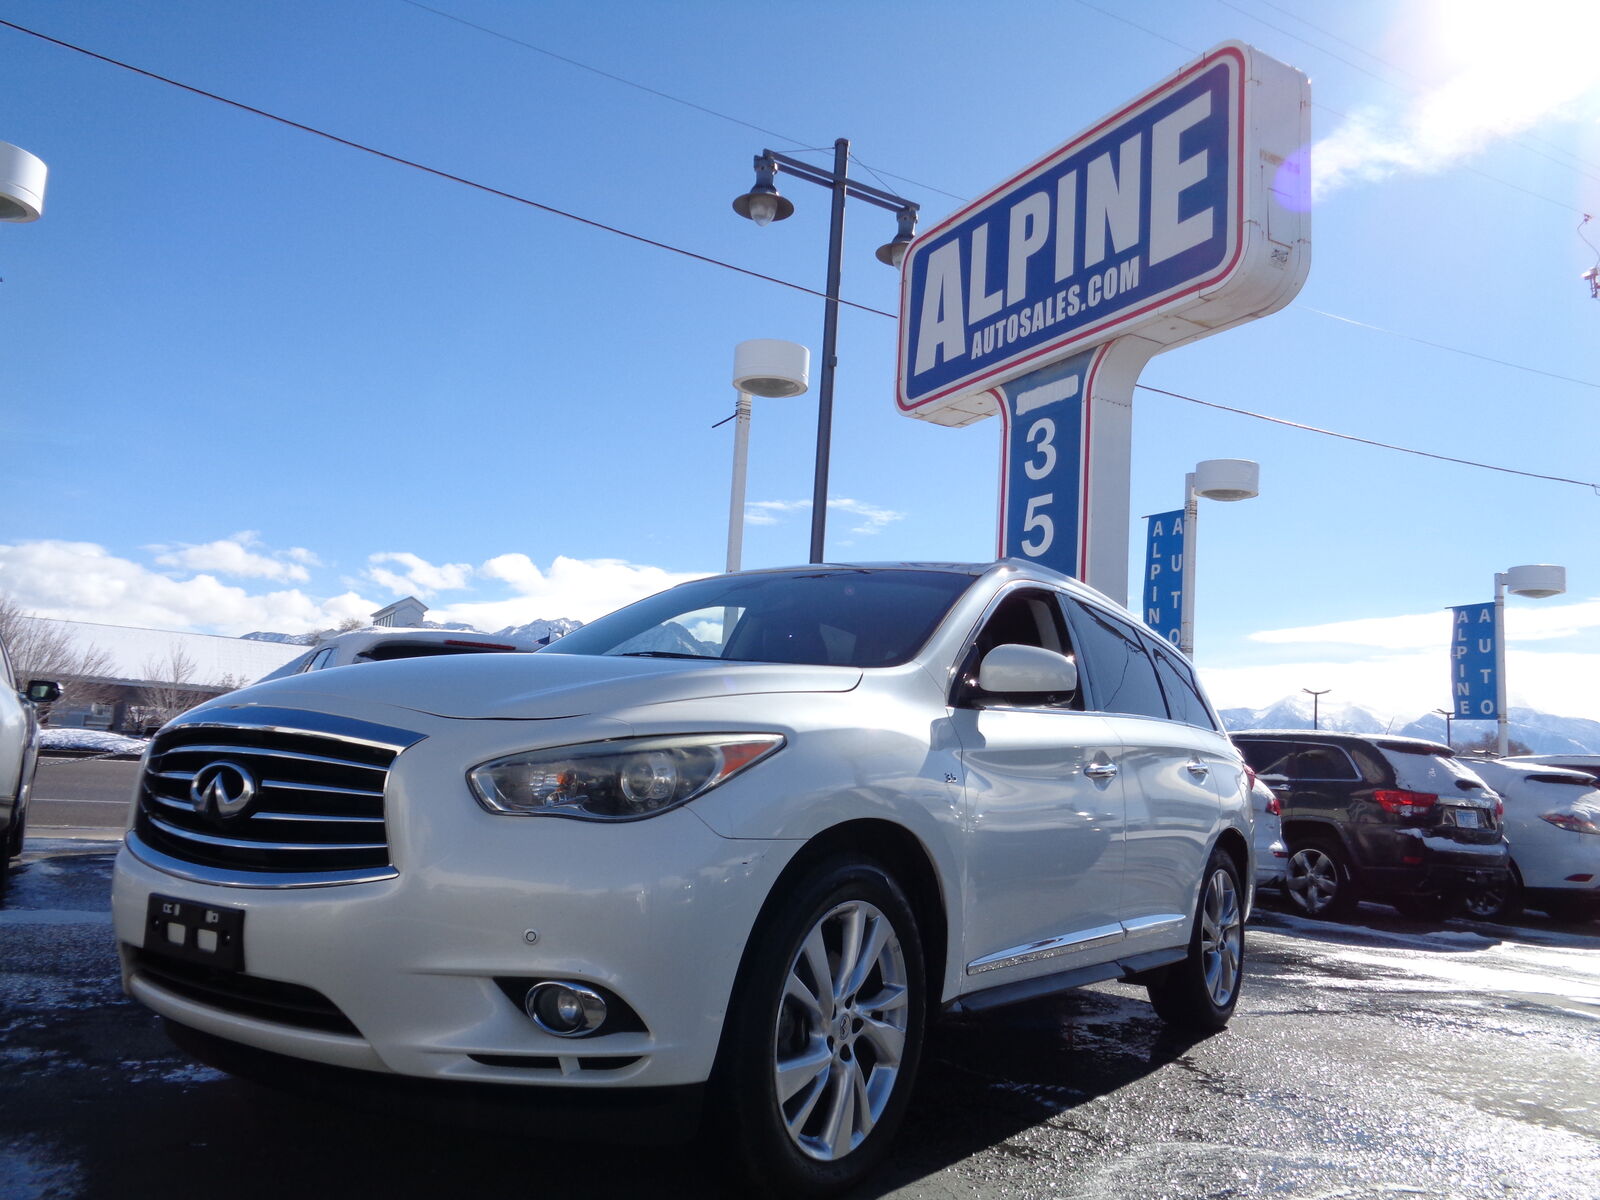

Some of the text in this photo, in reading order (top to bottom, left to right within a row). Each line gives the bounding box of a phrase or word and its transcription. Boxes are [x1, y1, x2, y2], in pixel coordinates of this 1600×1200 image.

[914, 90, 1214, 376] ALPINE
[971, 256, 1139, 360] AUTOSALES.COM
[1148, 521, 1163, 635] ALPIN
[1168, 517, 1184, 646] AUTO
[1457, 610, 1470, 715] ALPINE
[1478, 608, 1494, 715] AUTO
